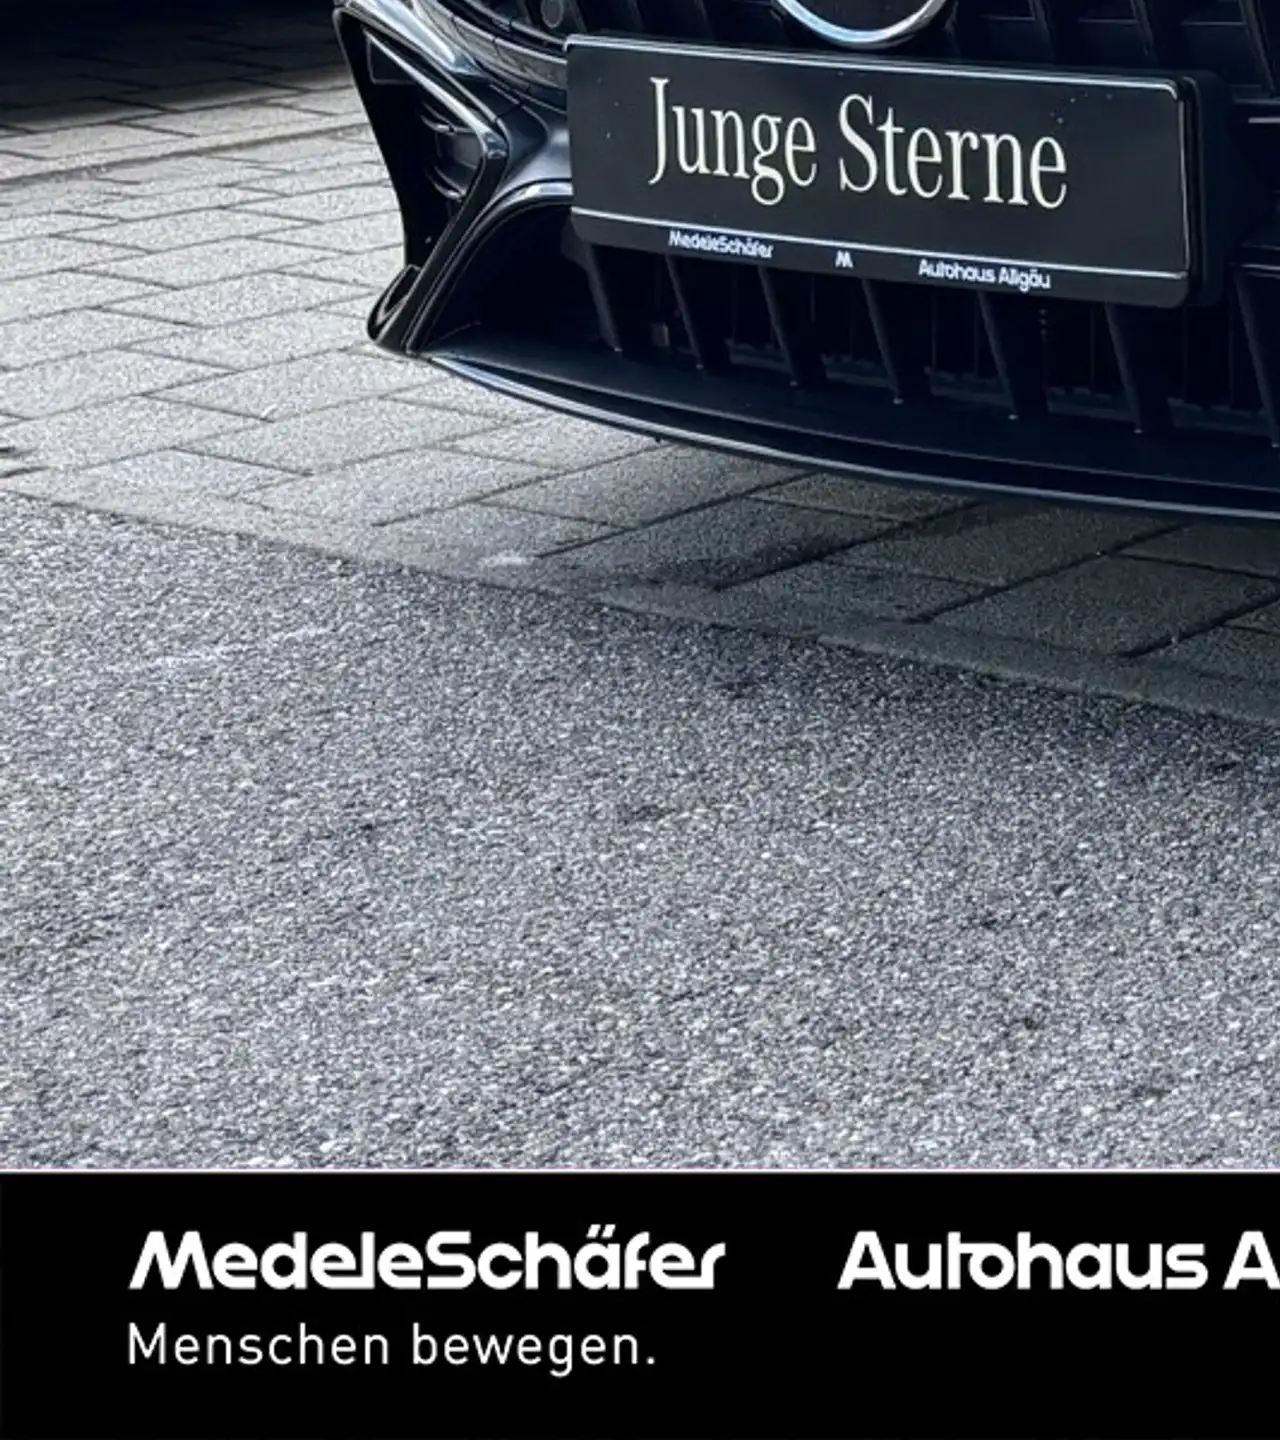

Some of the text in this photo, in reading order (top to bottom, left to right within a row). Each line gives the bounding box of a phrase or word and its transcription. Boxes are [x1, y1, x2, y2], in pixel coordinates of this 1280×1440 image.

[649, 76, 1068, 209] Junge Sterne
[668, 229, 774, 259] MedeleSchäfer
[918, 258, 997, 284] Autohaus
[998, 266, 1051, 293] Allgäu
